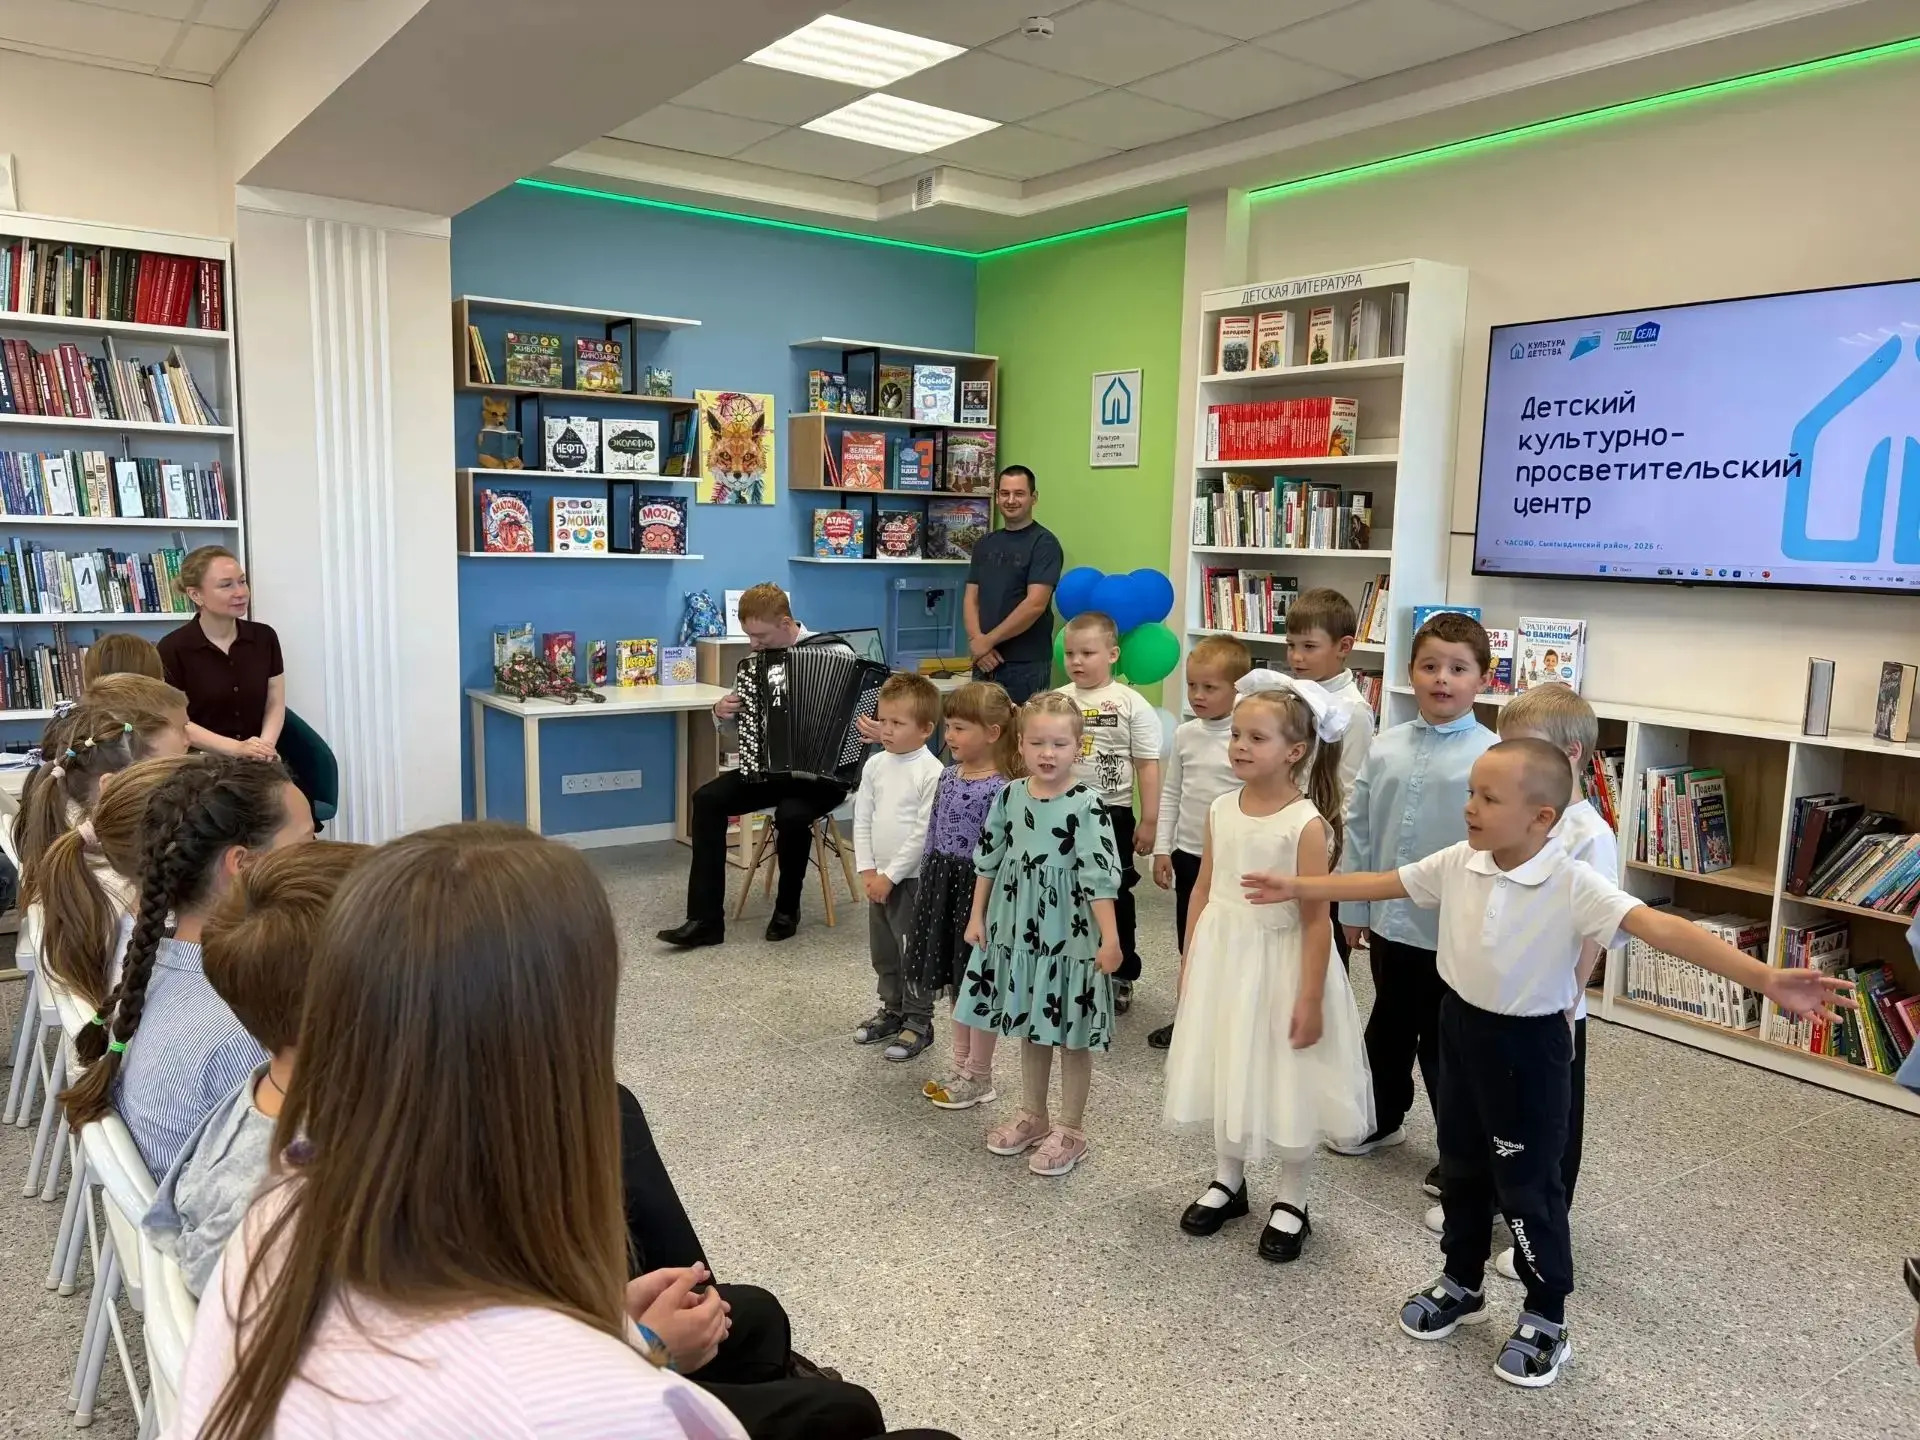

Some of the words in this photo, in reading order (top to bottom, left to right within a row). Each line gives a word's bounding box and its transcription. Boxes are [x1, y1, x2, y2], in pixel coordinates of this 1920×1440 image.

[1241, 284, 1288, 305] ДЕТСКАЯ
[1291, 273, 1363, 295] ЛИТЕРАТУРА
[1616, 330, 1633, 342] ГОД
[1636, 327, 1657, 339] СЕЛА
[514, 344, 555, 355] ЖИВОТНЫЕ
[1528, 339, 1566, 350] КУЛЬТУРА
[580, 351, 619, 361] ДИНОЗАВРЫ
[1527, 348, 1562, 358] ДЕТСТВА
[1521, 391, 1637, 421] Детский
[610, 438, 654, 448] ЭКОЛОГИЯ
[1518, 426, 1685, 454] культурно-
[556, 443, 586, 454] НЕФТЬ
[1515, 453, 1802, 487] просветительский
[51, 469, 61, 487] Г
[123, 471, 137, 493] Д
[170, 473, 181, 491] Е
[491, 500, 526, 515] АНАТОМИЯ
[642, 507, 675, 521] МОЗГ
[1513, 495, 1592, 519] центр
[557, 514, 605, 527] ЭМОЦИИ
[826, 516, 851, 524] АТЛАС
[1525, 623, 1571, 633] РАЗГОВОРЫ
[1533, 631, 1571, 640] ВАЖНОМ
[1103, 767, 1118, 778] THE
[1101, 774, 1120, 793] CITY
[1493, 1136, 1525, 1150] Reebok
[1511, 1218, 1537, 1264] Reebok
